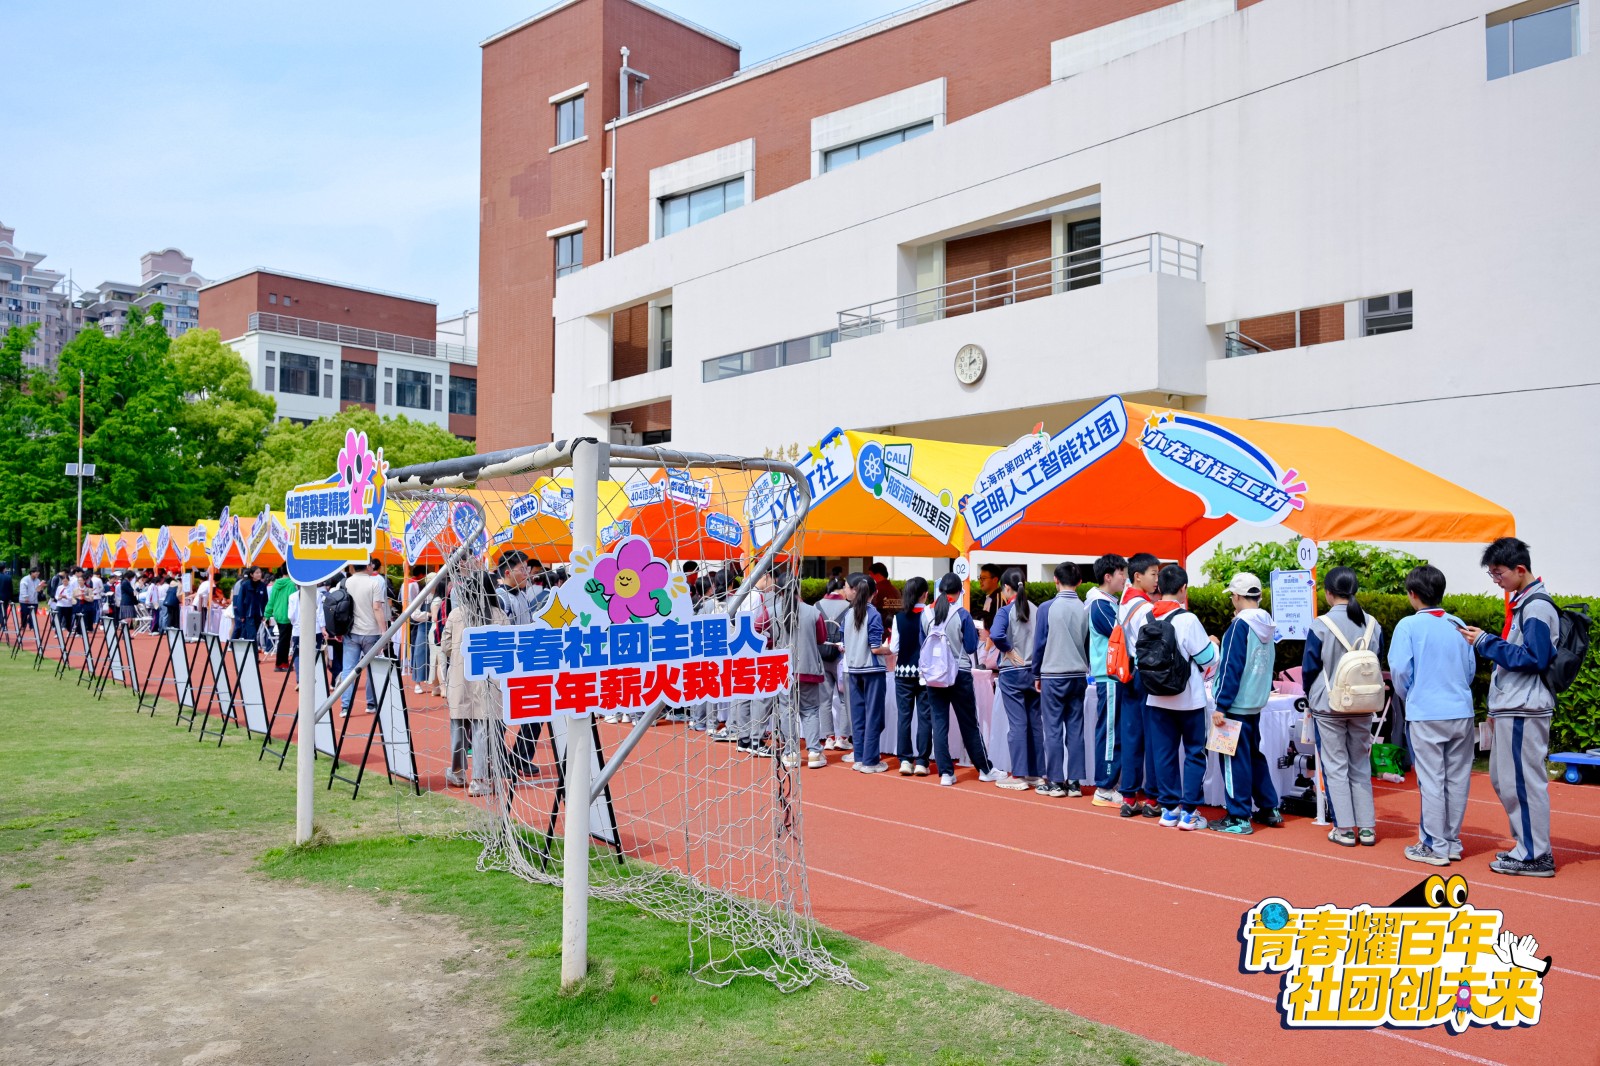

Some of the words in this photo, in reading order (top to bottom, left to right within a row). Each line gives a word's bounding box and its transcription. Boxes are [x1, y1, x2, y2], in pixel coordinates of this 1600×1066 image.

[886, 451, 908, 466] CALL
[971, 410, 1120, 528] 启明人工智能社团
[980, 440, 1044, 494] 上海市第四中学
[1141, 430, 1291, 512] 小龙对话工坊
[300, 518, 373, 545] 青春奋斗正当时
[885, 475, 952, 536] 脑洞物理局
[956, 563, 967, 575] 02
[1300, 547, 1312, 561] 01
[467, 615, 766, 676] 青春社团主理人
[507, 653, 790, 720] 百年薪火我传承
